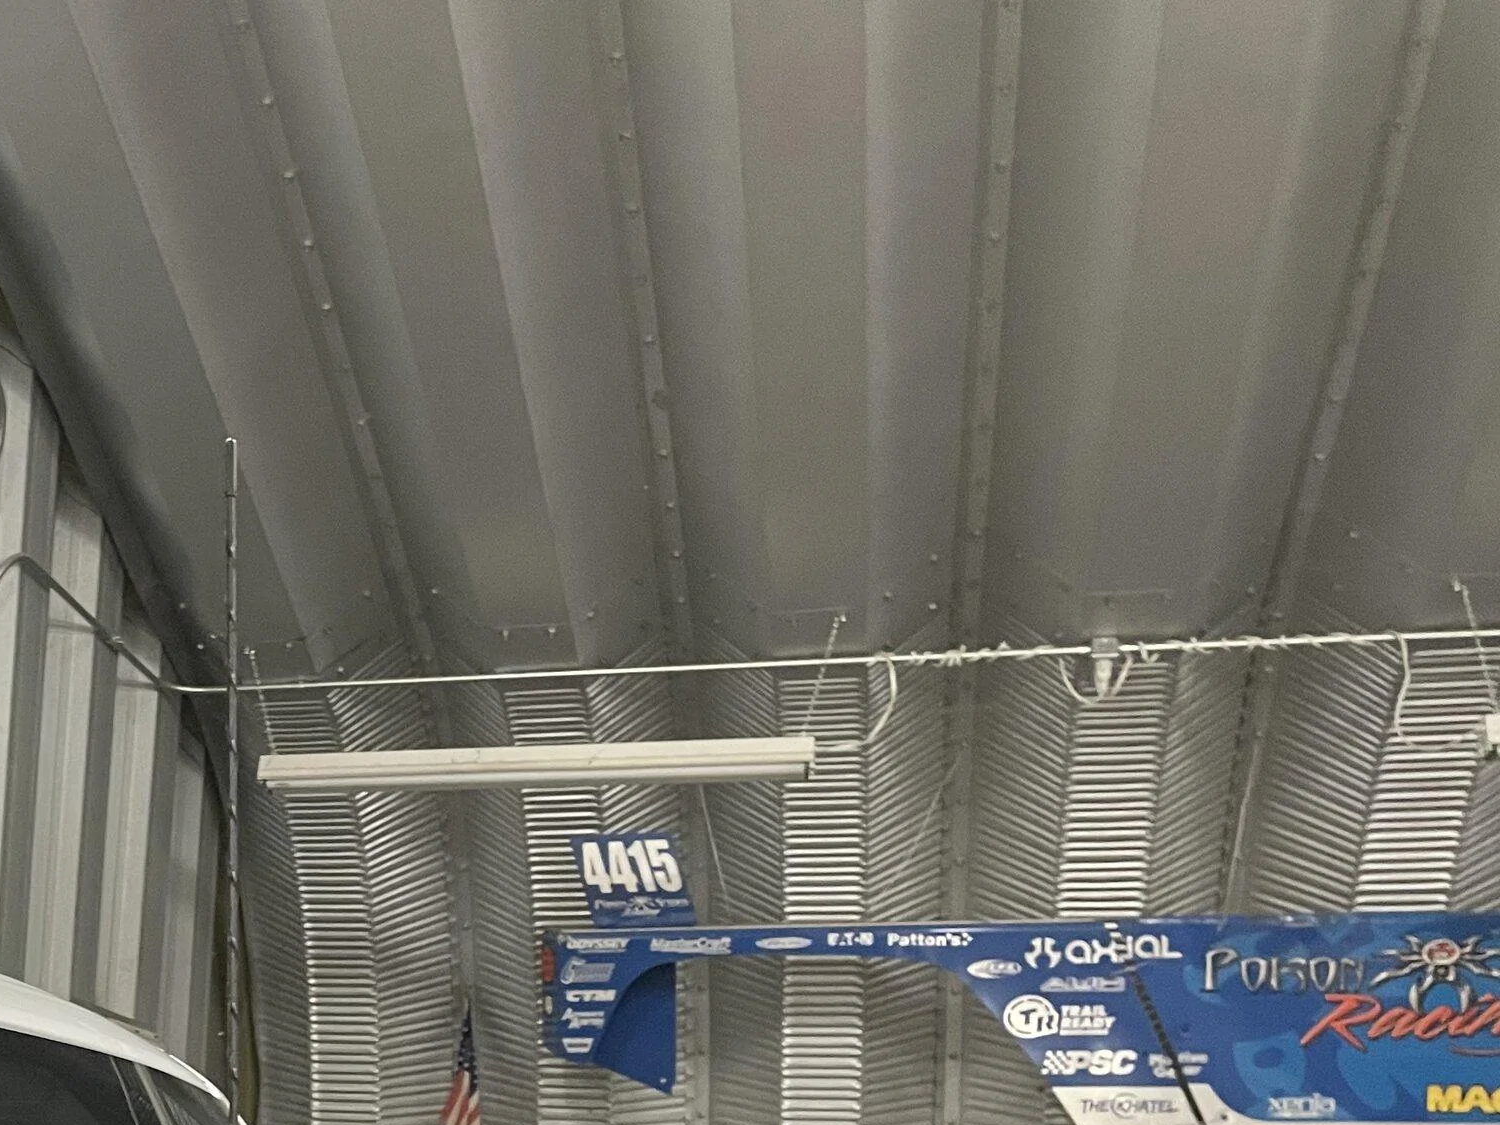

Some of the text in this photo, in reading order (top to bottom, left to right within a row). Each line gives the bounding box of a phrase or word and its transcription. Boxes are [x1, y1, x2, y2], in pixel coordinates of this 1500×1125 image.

[581, 838, 684, 894] 4415
[886, 932, 961, 947] Patton's
[1060, 1004, 1108, 1017] TRAIL
[1066, 1049, 1139, 1076] PSC
